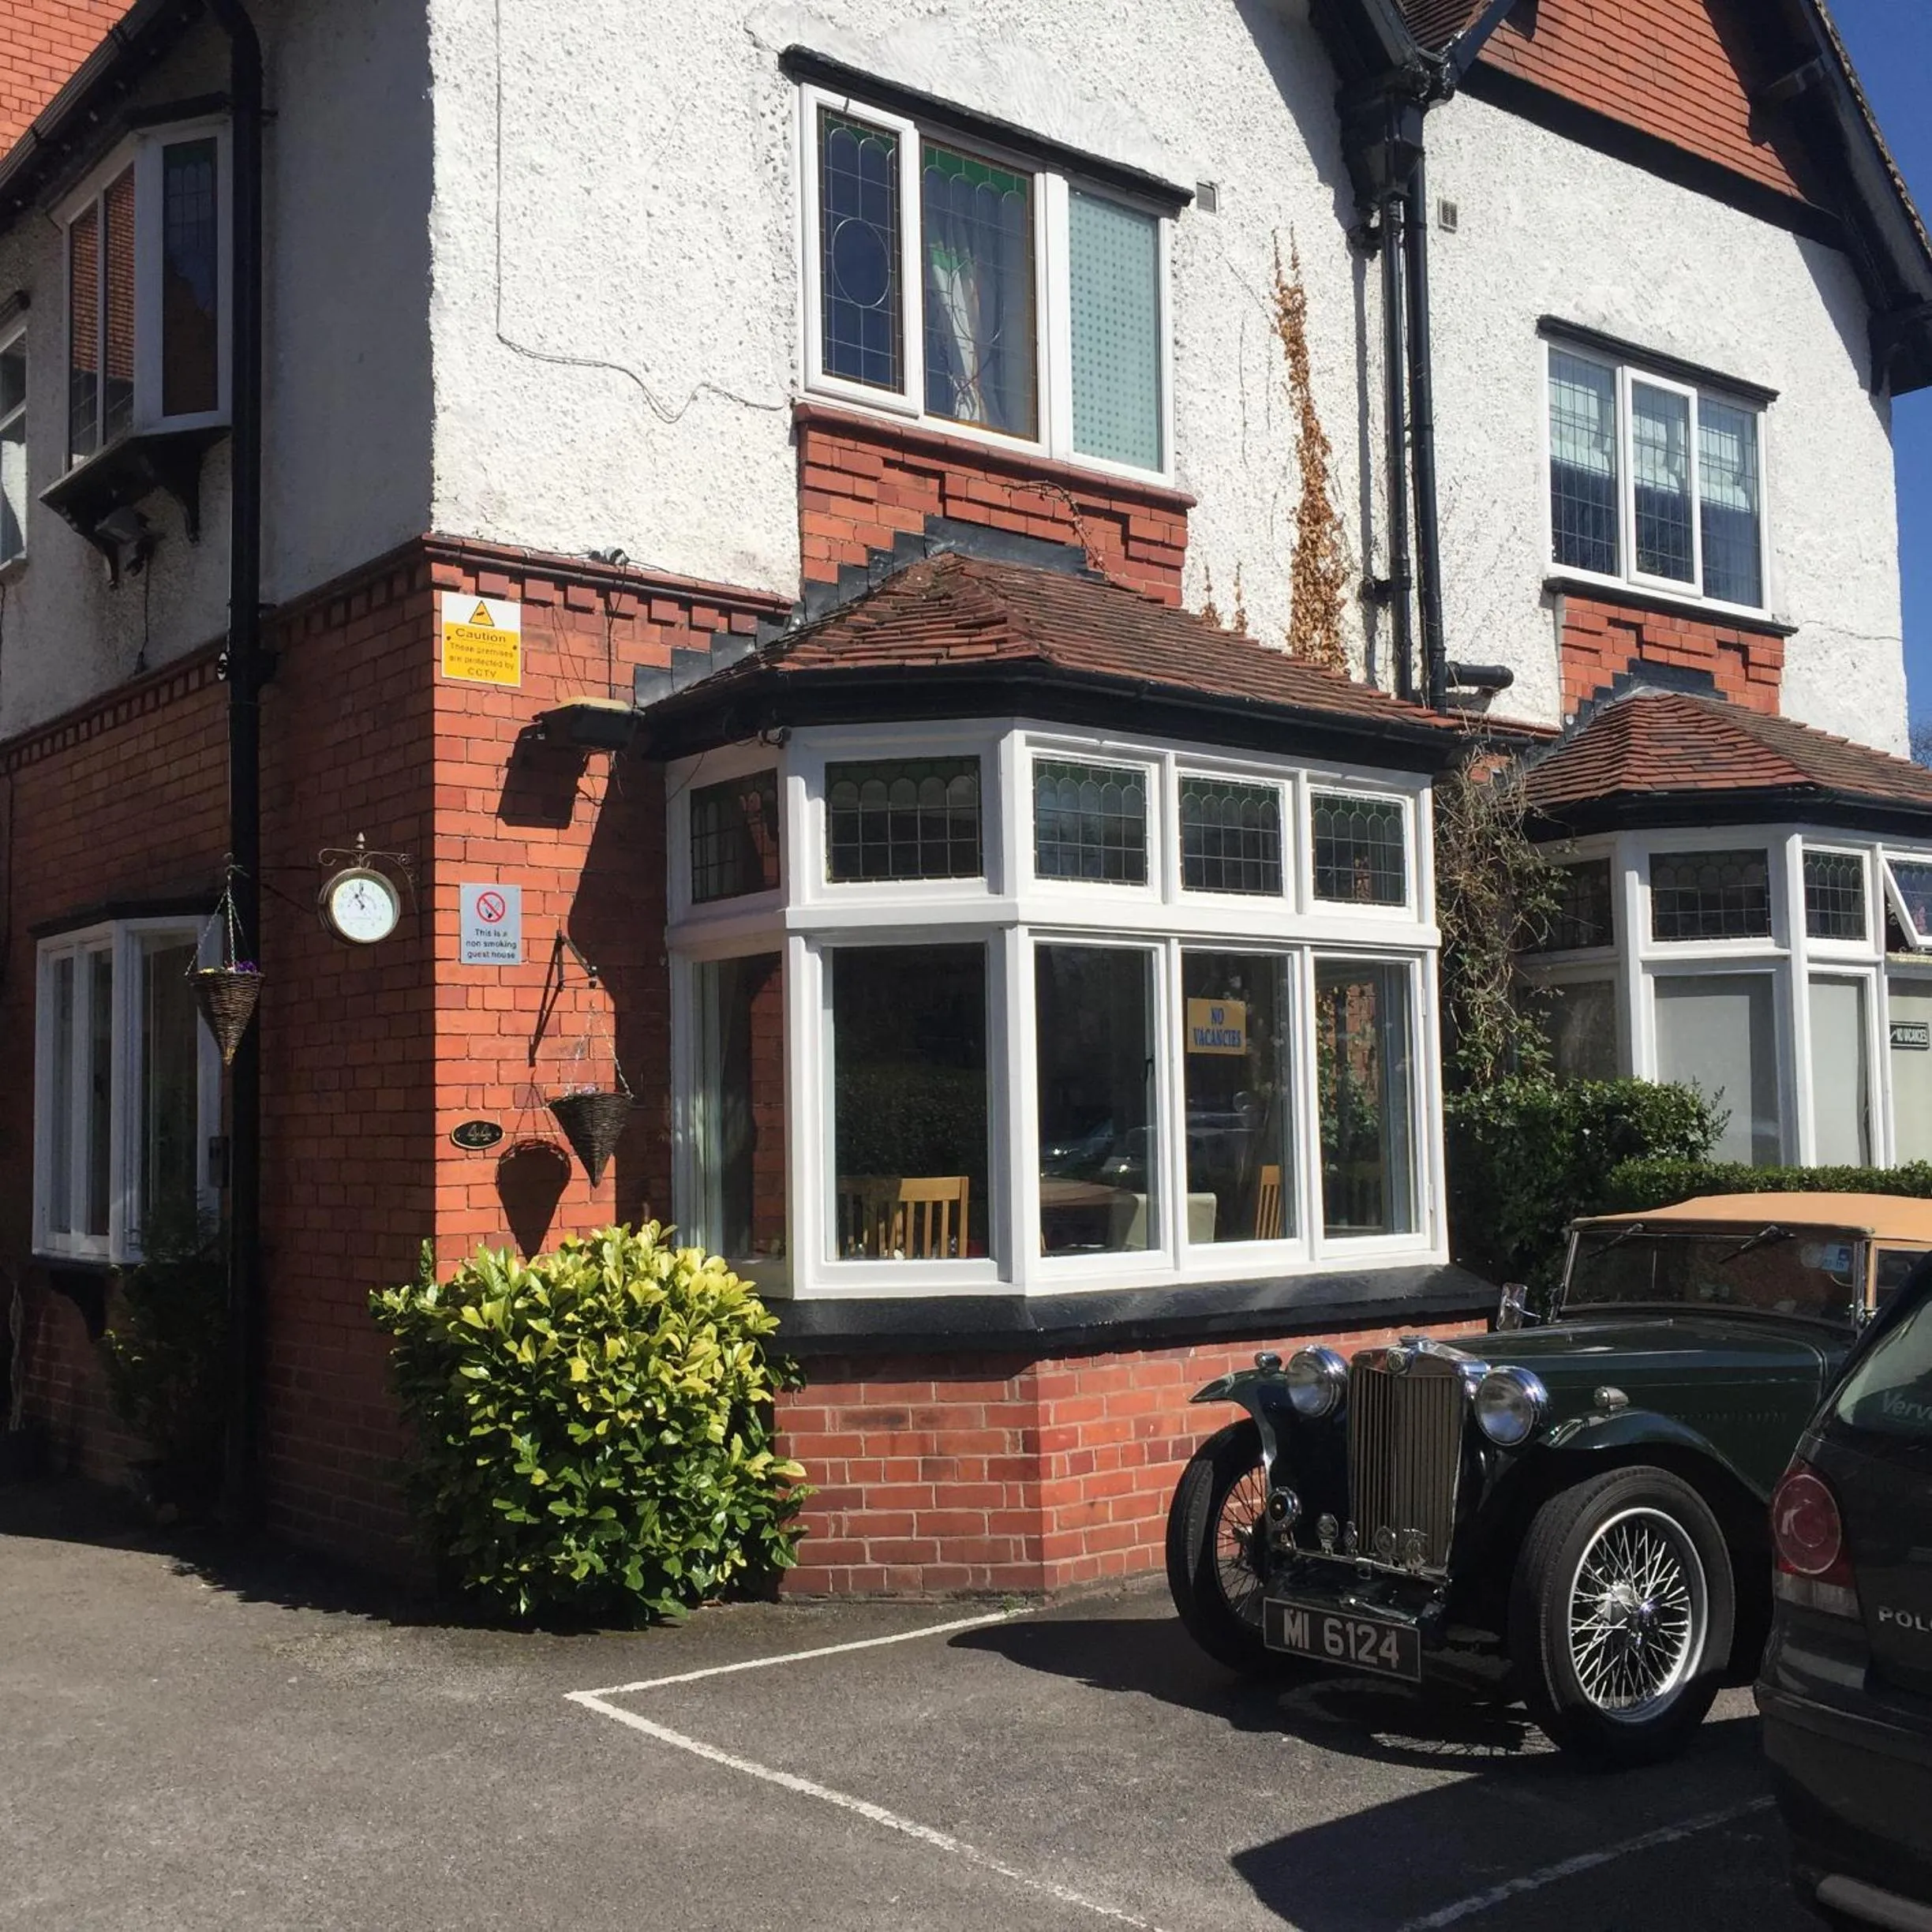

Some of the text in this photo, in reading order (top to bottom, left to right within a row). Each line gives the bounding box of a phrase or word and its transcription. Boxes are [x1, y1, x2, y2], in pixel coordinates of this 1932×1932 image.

[455, 628, 506, 643] Caution
[465, 657, 503, 668] protected
[504, 660, 515, 671] by
[467, 668, 497, 678] CCTV
[474, 928, 492, 937] This
[483, 940, 518, 950] smoking
[1211, 1007, 1225, 1025] NO
[1193, 1027, 1241, 1048] VACANCIES
[467, 1124, 492, 1142] 44
[1878, 1605, 1932, 1633] POL
[1283, 1608, 1400, 1669] MI 6124
